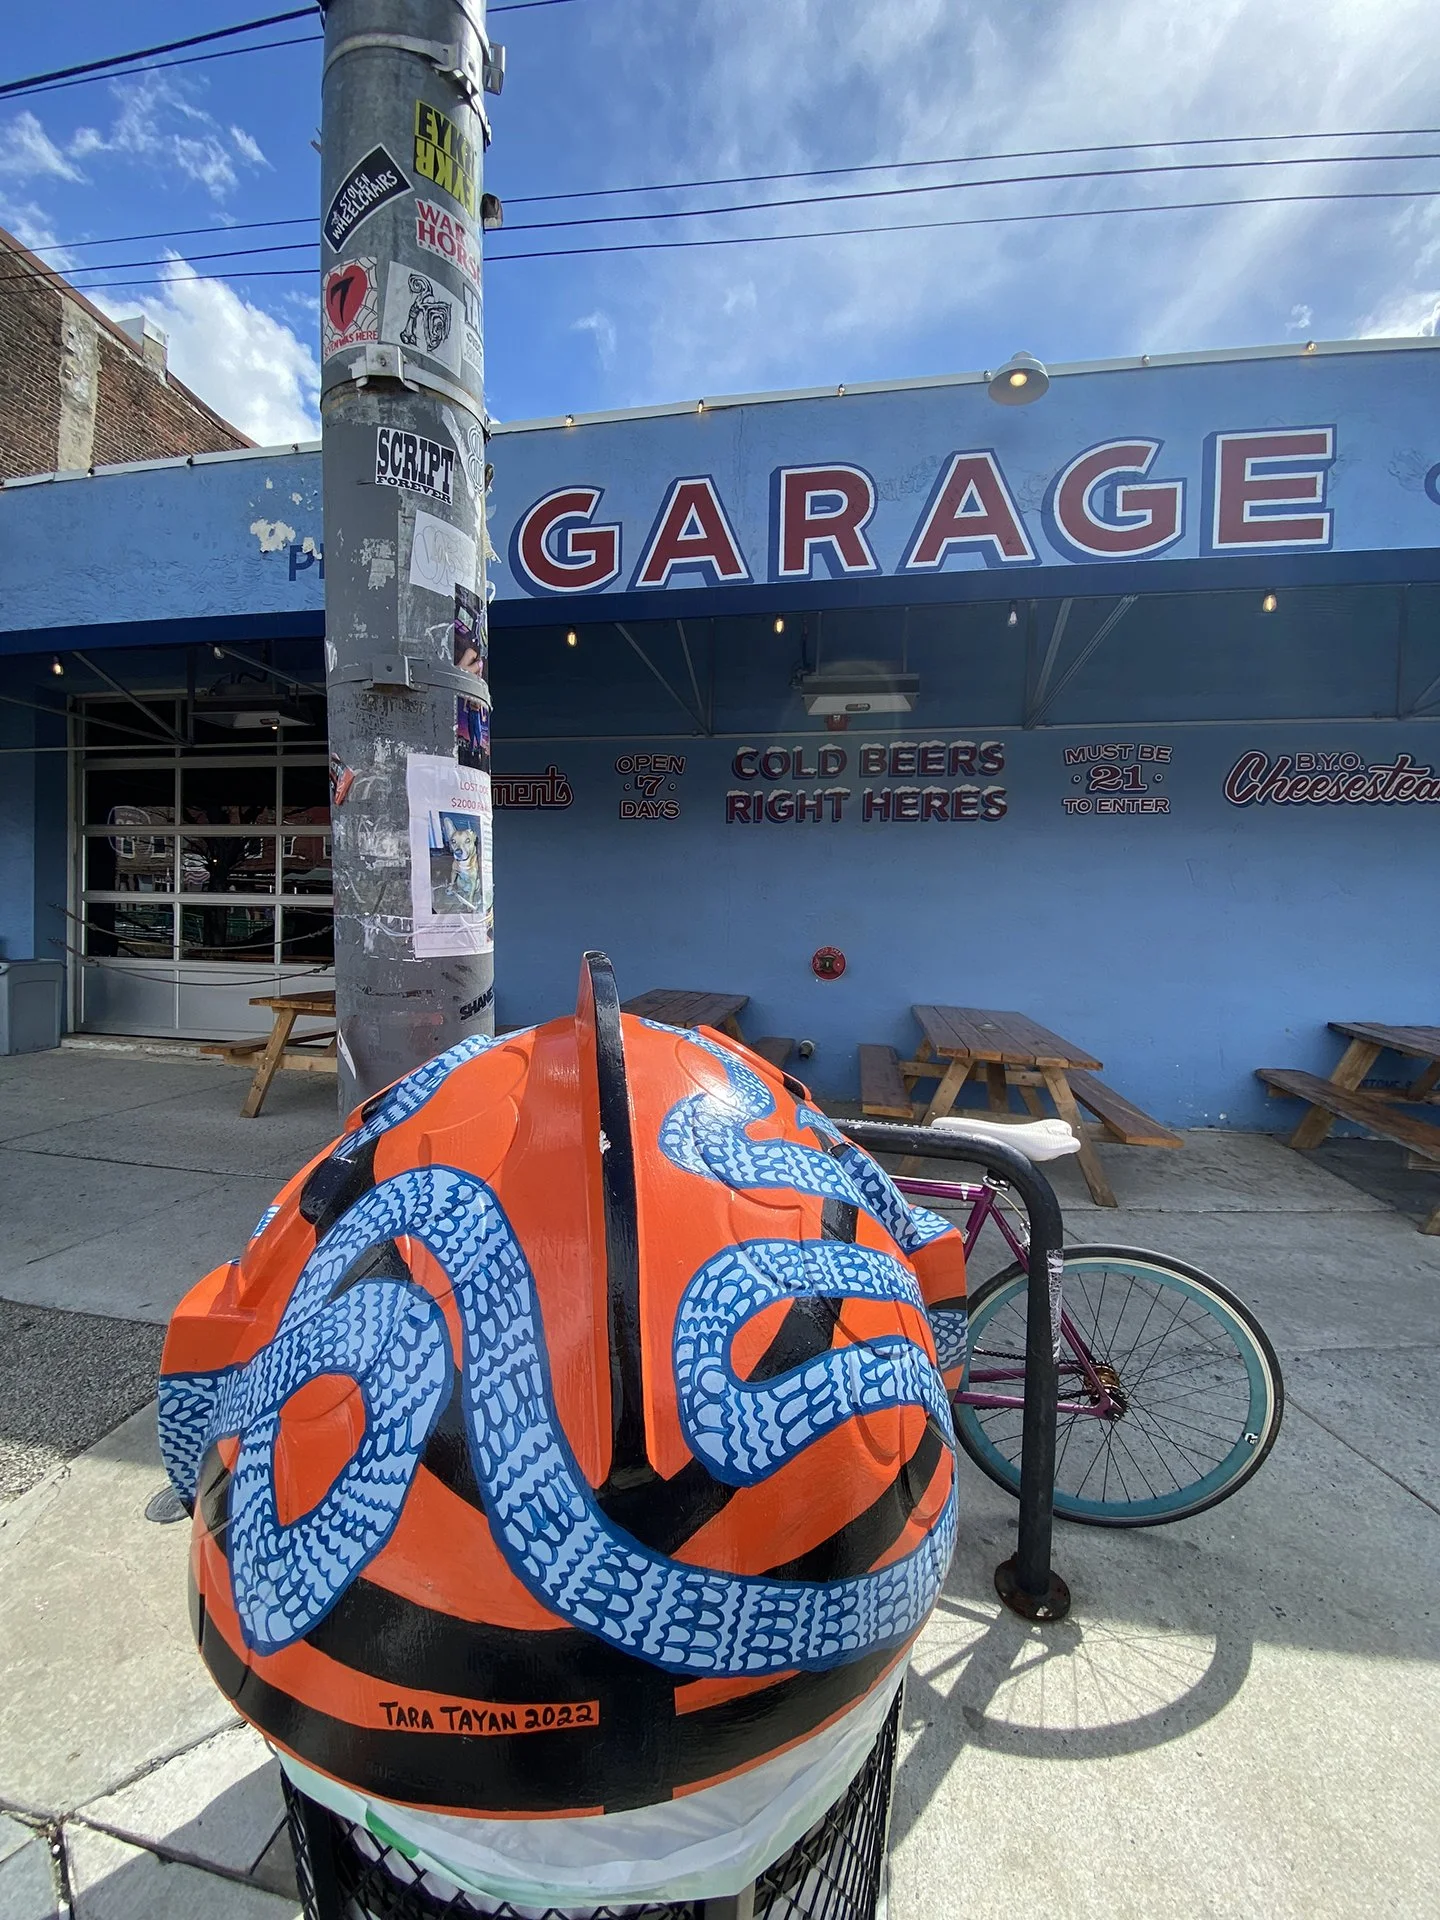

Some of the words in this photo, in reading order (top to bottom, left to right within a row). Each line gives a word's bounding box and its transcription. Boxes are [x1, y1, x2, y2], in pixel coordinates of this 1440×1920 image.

[332, 170, 398, 240] WHEELCHAIRS
[340, 173, 371, 210] STOLEN
[417, 200, 466, 247] WAR
[356, 330, 378, 341] HERE
[377, 428, 454, 495] SCRIPT
[376, 475, 452, 504] FOREVER
[512, 424, 1337, 595] GARAGE
[616, 754, 686, 774] OPEN
[732, 743, 848, 780] COLD
[859, 740, 1005, 778] BEERS
[1065, 744, 1135, 764] MUST
[1138, 744, 1172, 762] BE
[460, 781, 478, 791] LOST
[490, 766, 573, 807] ments
[637, 774, 666, 796] 7
[1089, 764, 1147, 791] 21
[451, 797, 476, 809] $2000
[620, 800, 681, 818] DAYS
[726, 787, 851, 824] RIGHT
[862, 784, 1009, 823] HERES
[1063, 798, 1093, 814] TO
[1096, 798, 1170, 814] ENTER
[379, 1701, 434, 1730] TARA
[440, 1705, 517, 1732] TAYAN
[524, 1704, 595, 1730] 2022
